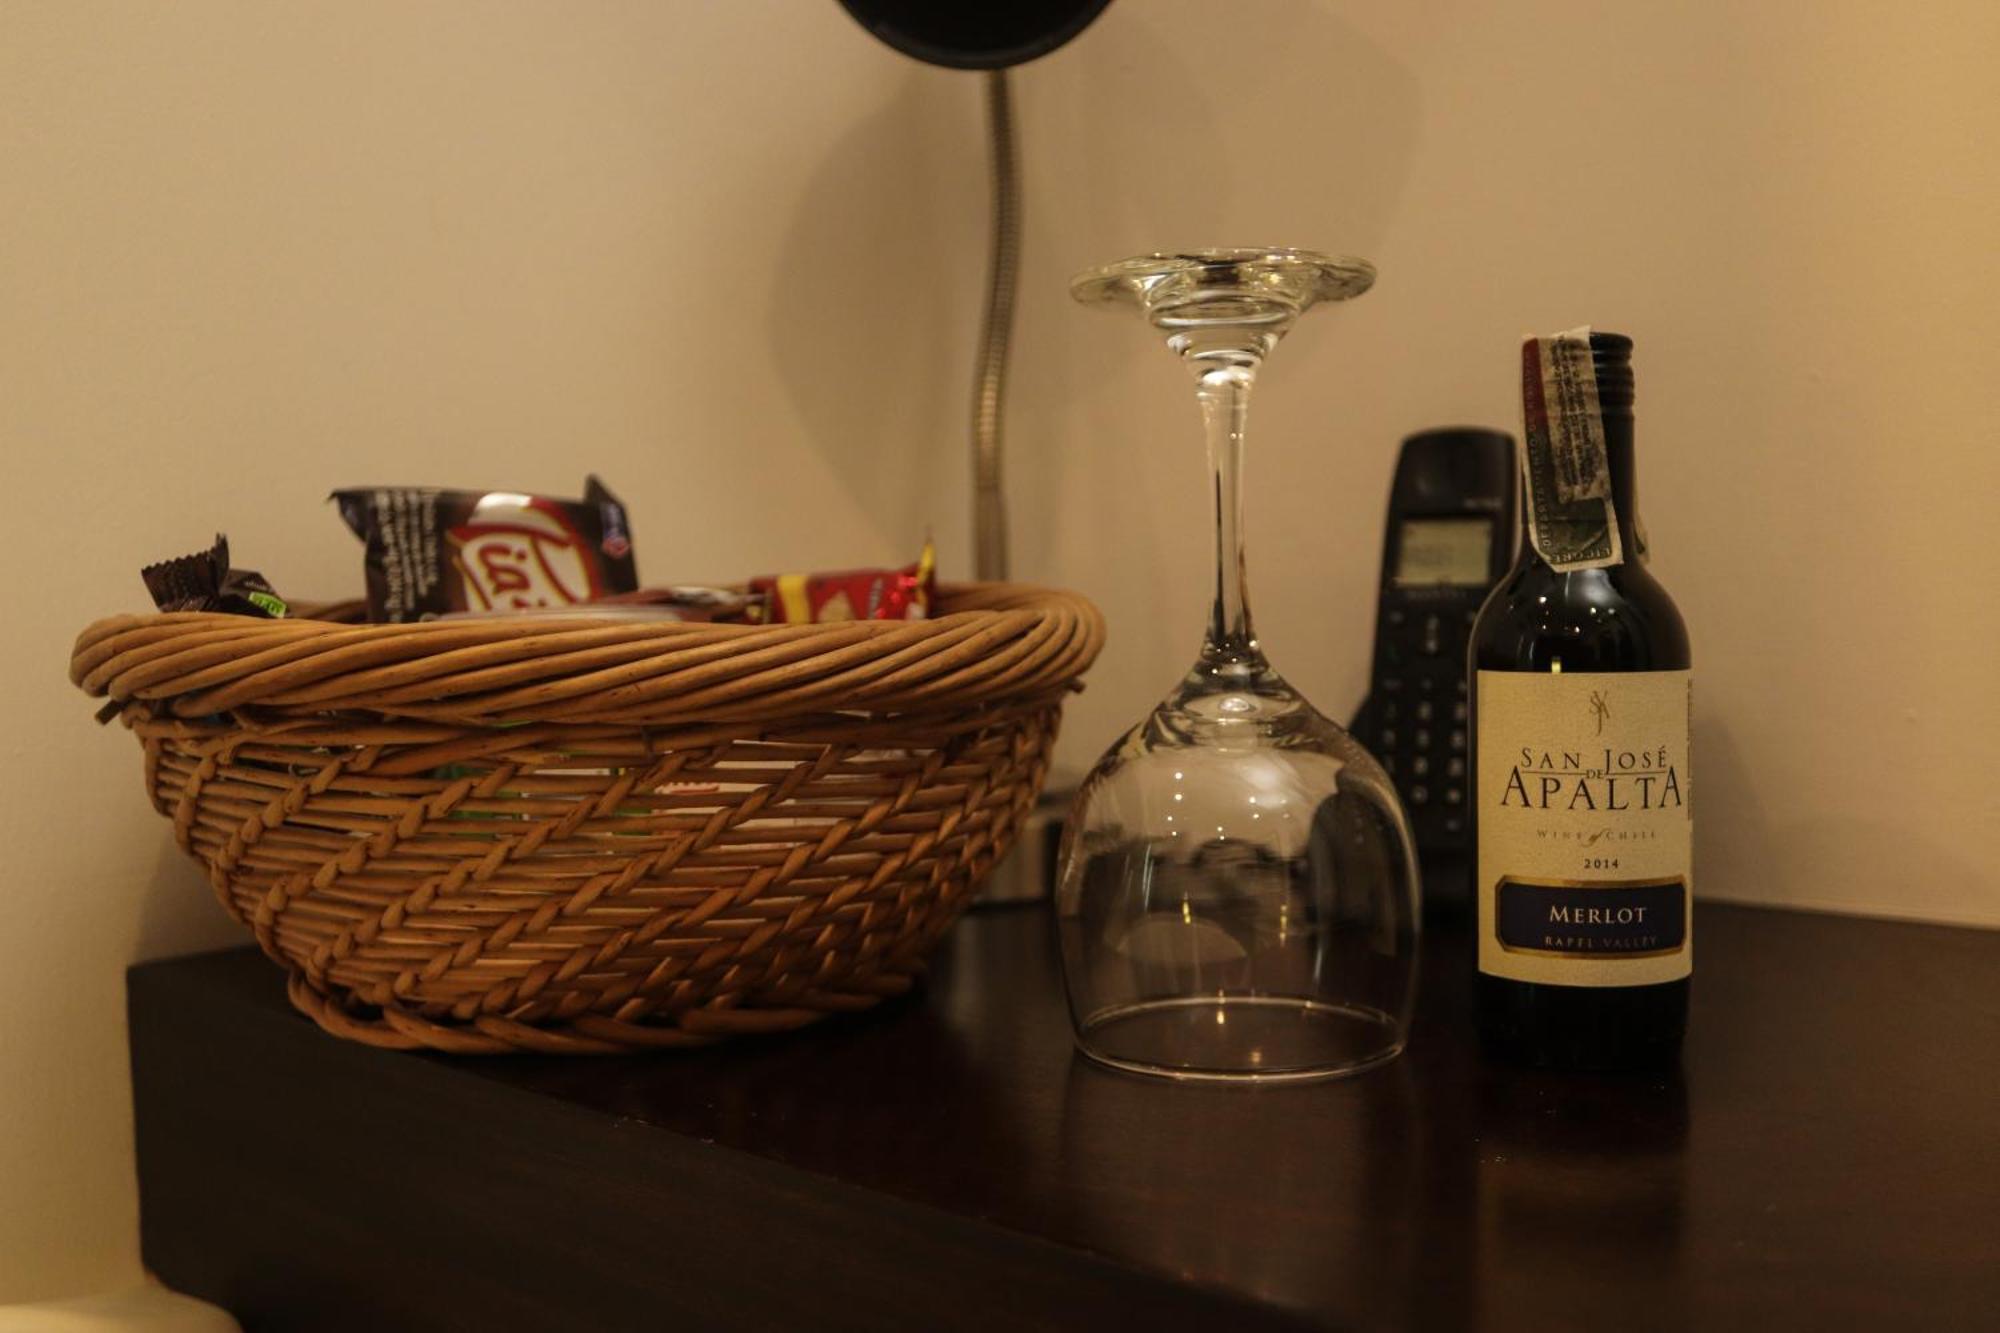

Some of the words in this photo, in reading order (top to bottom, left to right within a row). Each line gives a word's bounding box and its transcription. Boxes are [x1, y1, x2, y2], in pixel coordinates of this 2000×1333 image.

[1520, 747, 1580, 769] SAN
[1604, 745, 1667, 775] JOSÉ
[1585, 769, 1605, 780] DE
[1500, 765, 1682, 811] APALTA
[1584, 858, 1619, 869] 2014
[1549, 905, 1647, 924] MERLOT
